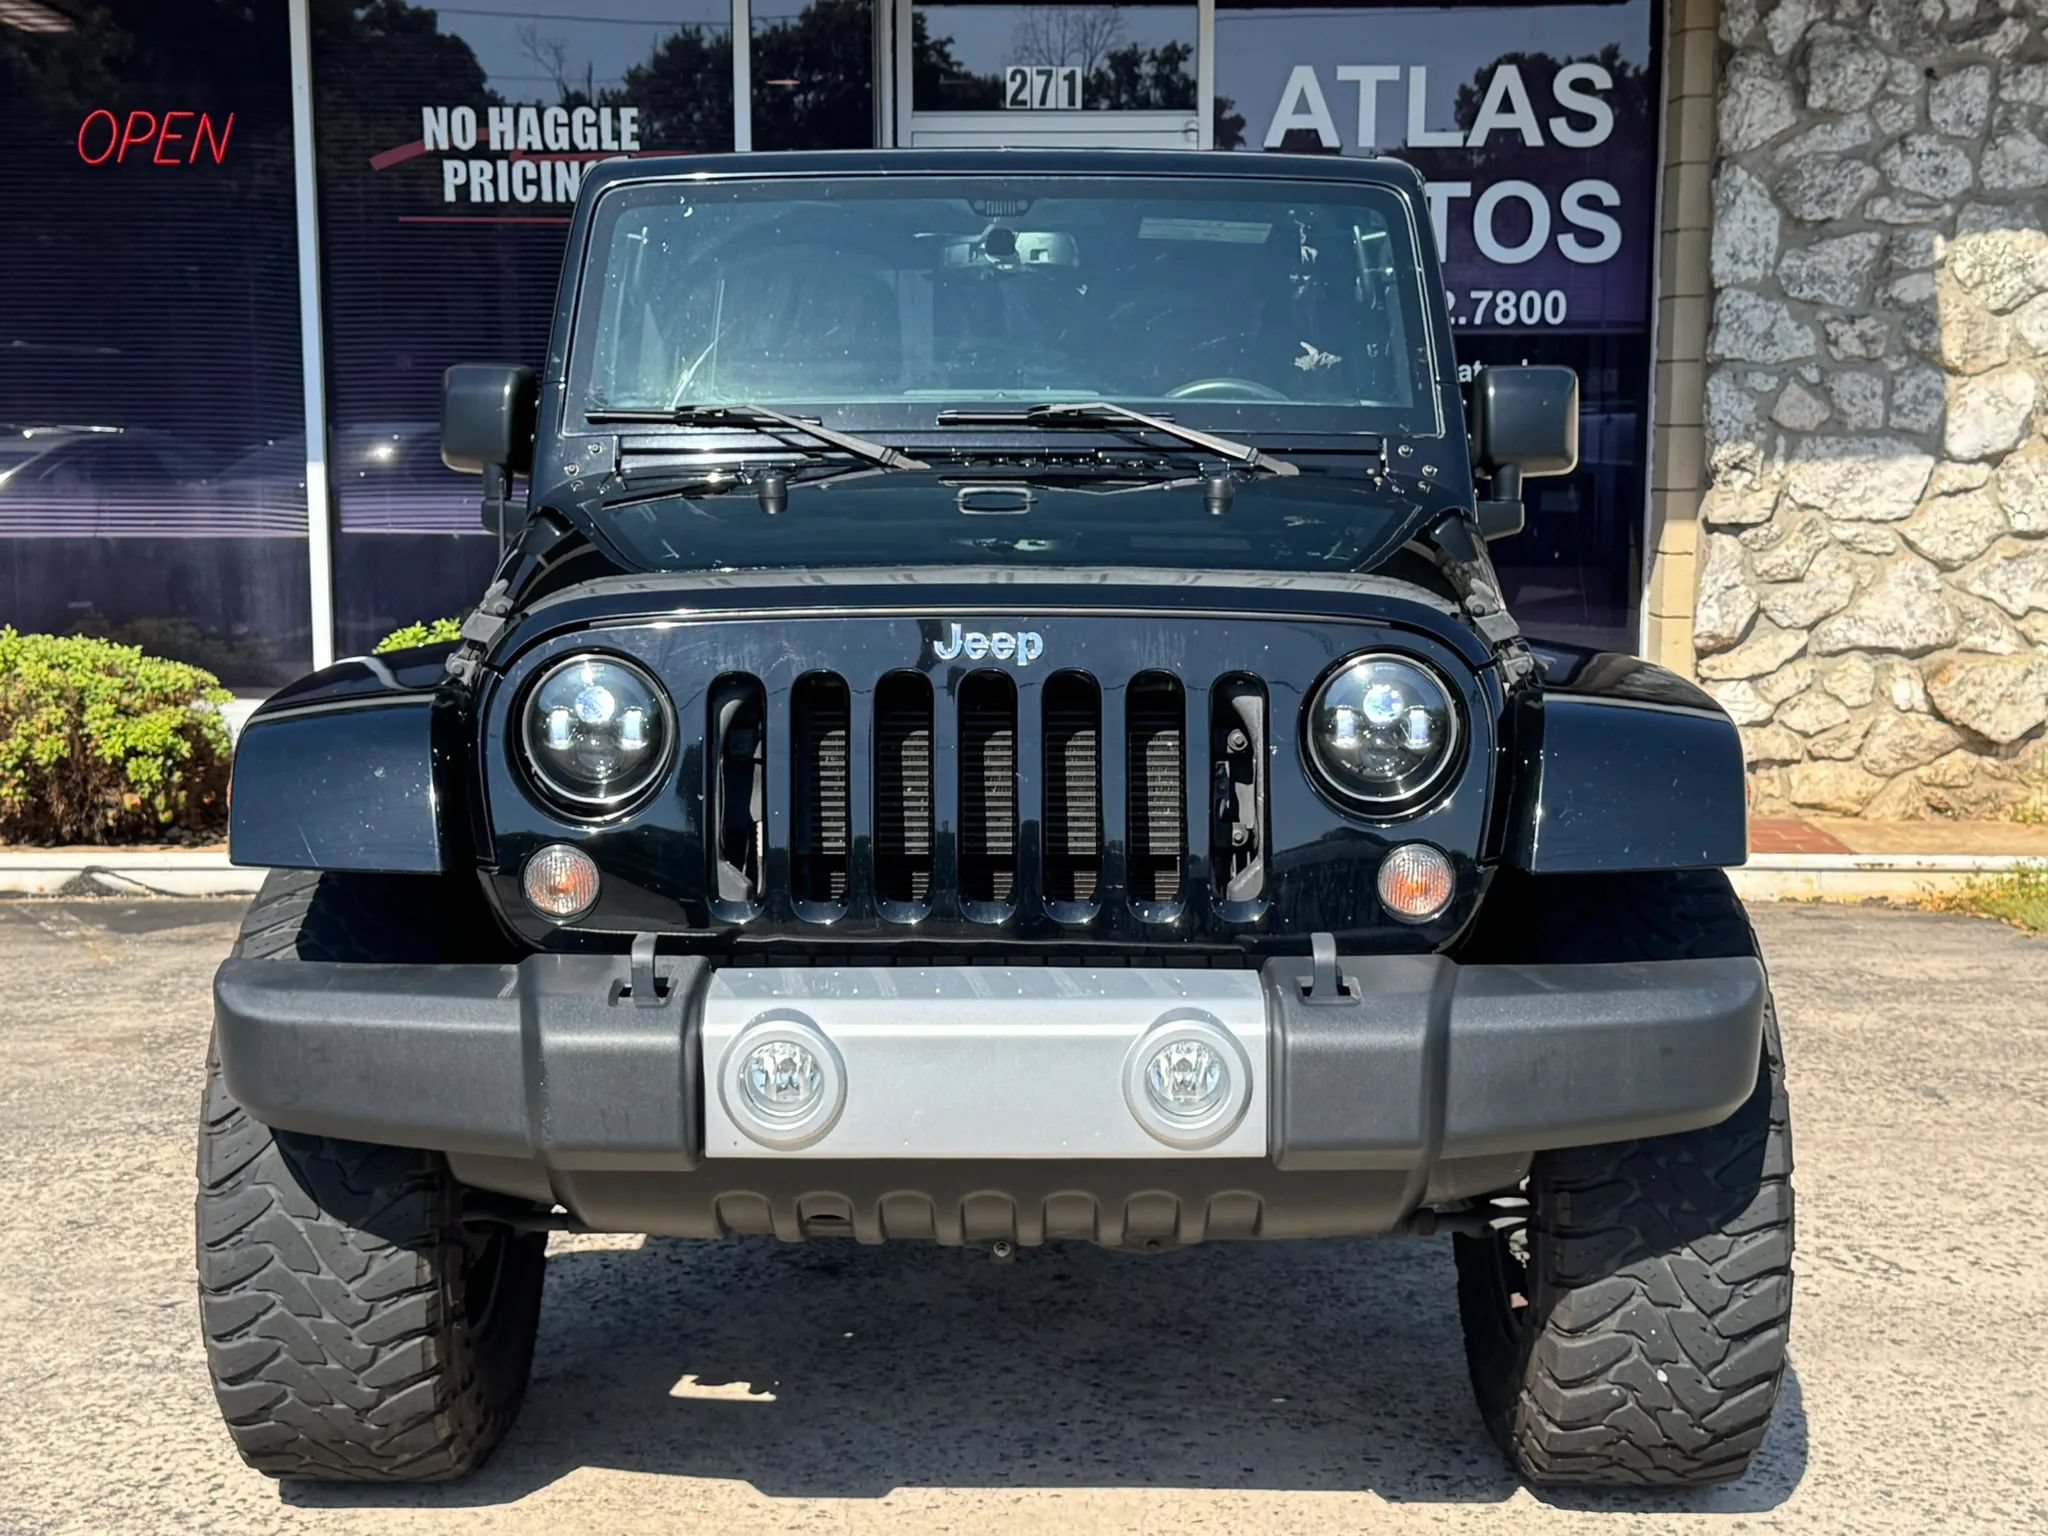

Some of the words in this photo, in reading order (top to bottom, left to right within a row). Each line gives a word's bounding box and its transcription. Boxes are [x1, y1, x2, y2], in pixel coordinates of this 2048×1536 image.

[1009, 68, 1077, 107] 271
[1263, 63, 1614, 148] ATLAS
[78, 109, 236, 164] OPEN
[422, 106, 477, 151] NO
[488, 106, 640, 151] HAGGLE
[442, 159, 598, 203] PRICIN
[1424, 179, 1622, 264] TOS
[933, 623, 1043, 666] Jeep
